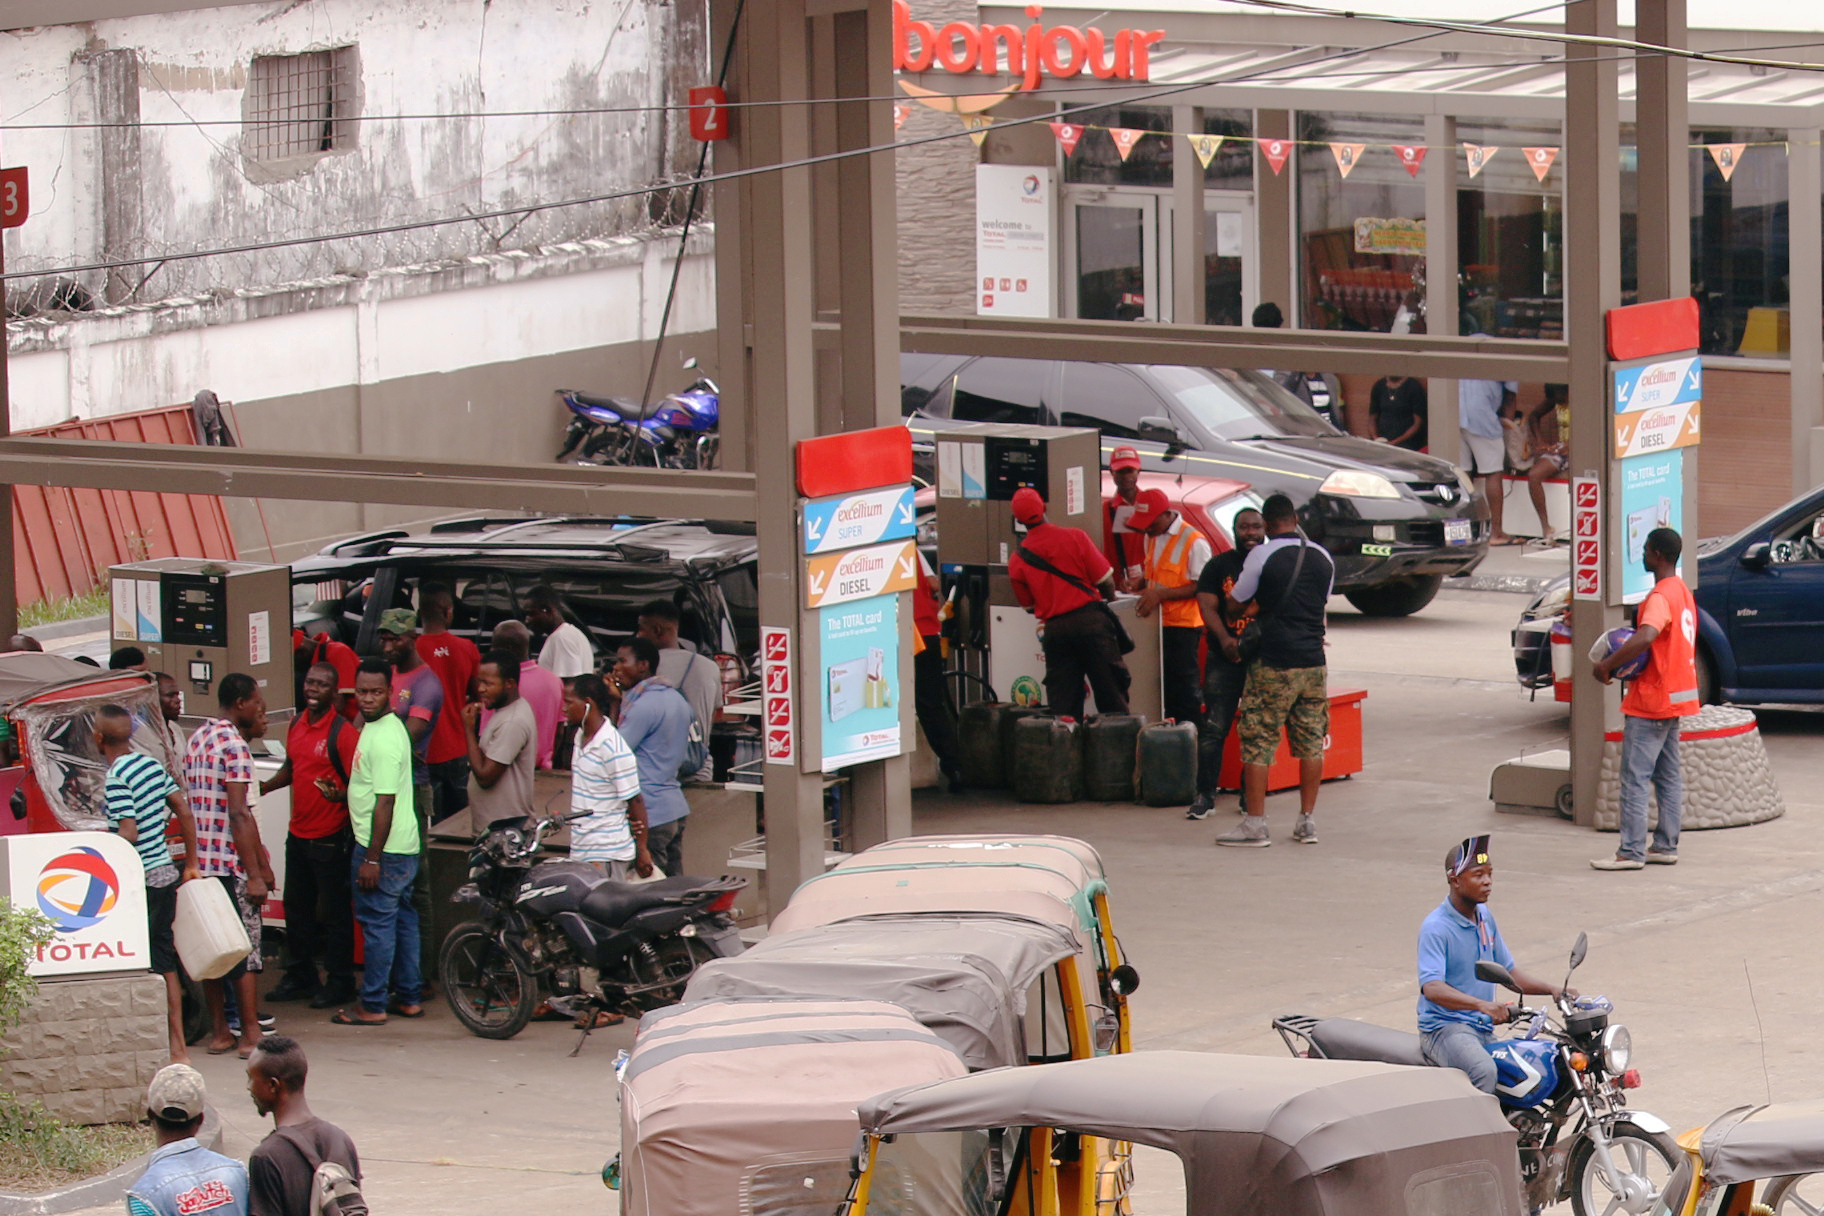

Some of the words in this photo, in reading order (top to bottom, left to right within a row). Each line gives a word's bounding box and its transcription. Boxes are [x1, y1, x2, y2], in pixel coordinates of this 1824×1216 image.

[894, 0, 1166, 93] bonjour
[704, 99, 720, 132] 2
[4, 182, 18, 216] 3
[982, 218, 1023, 230] welcome
[1641, 369, 1677, 387] excellium
[1641, 391, 1661, 402] SUPER
[1640, 412, 1676, 431] excellium
[1640, 432, 1665, 449] DIESEL
[1627, 469, 1638, 481] The
[1638, 466, 1656, 479] TOTAL
[1656, 463, 1671, 476] card
[837, 500, 883, 522] excellium
[838, 525, 863, 540] SUPER
[839, 555, 884, 577] excellium
[839, 581, 871, 597] DIESEL
[827, 617, 842, 631] The
[841, 613, 865, 629] TOTAL
[865, 610, 882, 625] card
[115, 630, 136, 639] DIESEL
[36, 940, 136, 963] TOTAL
[1492, 1050, 1509, 1060] TVS
